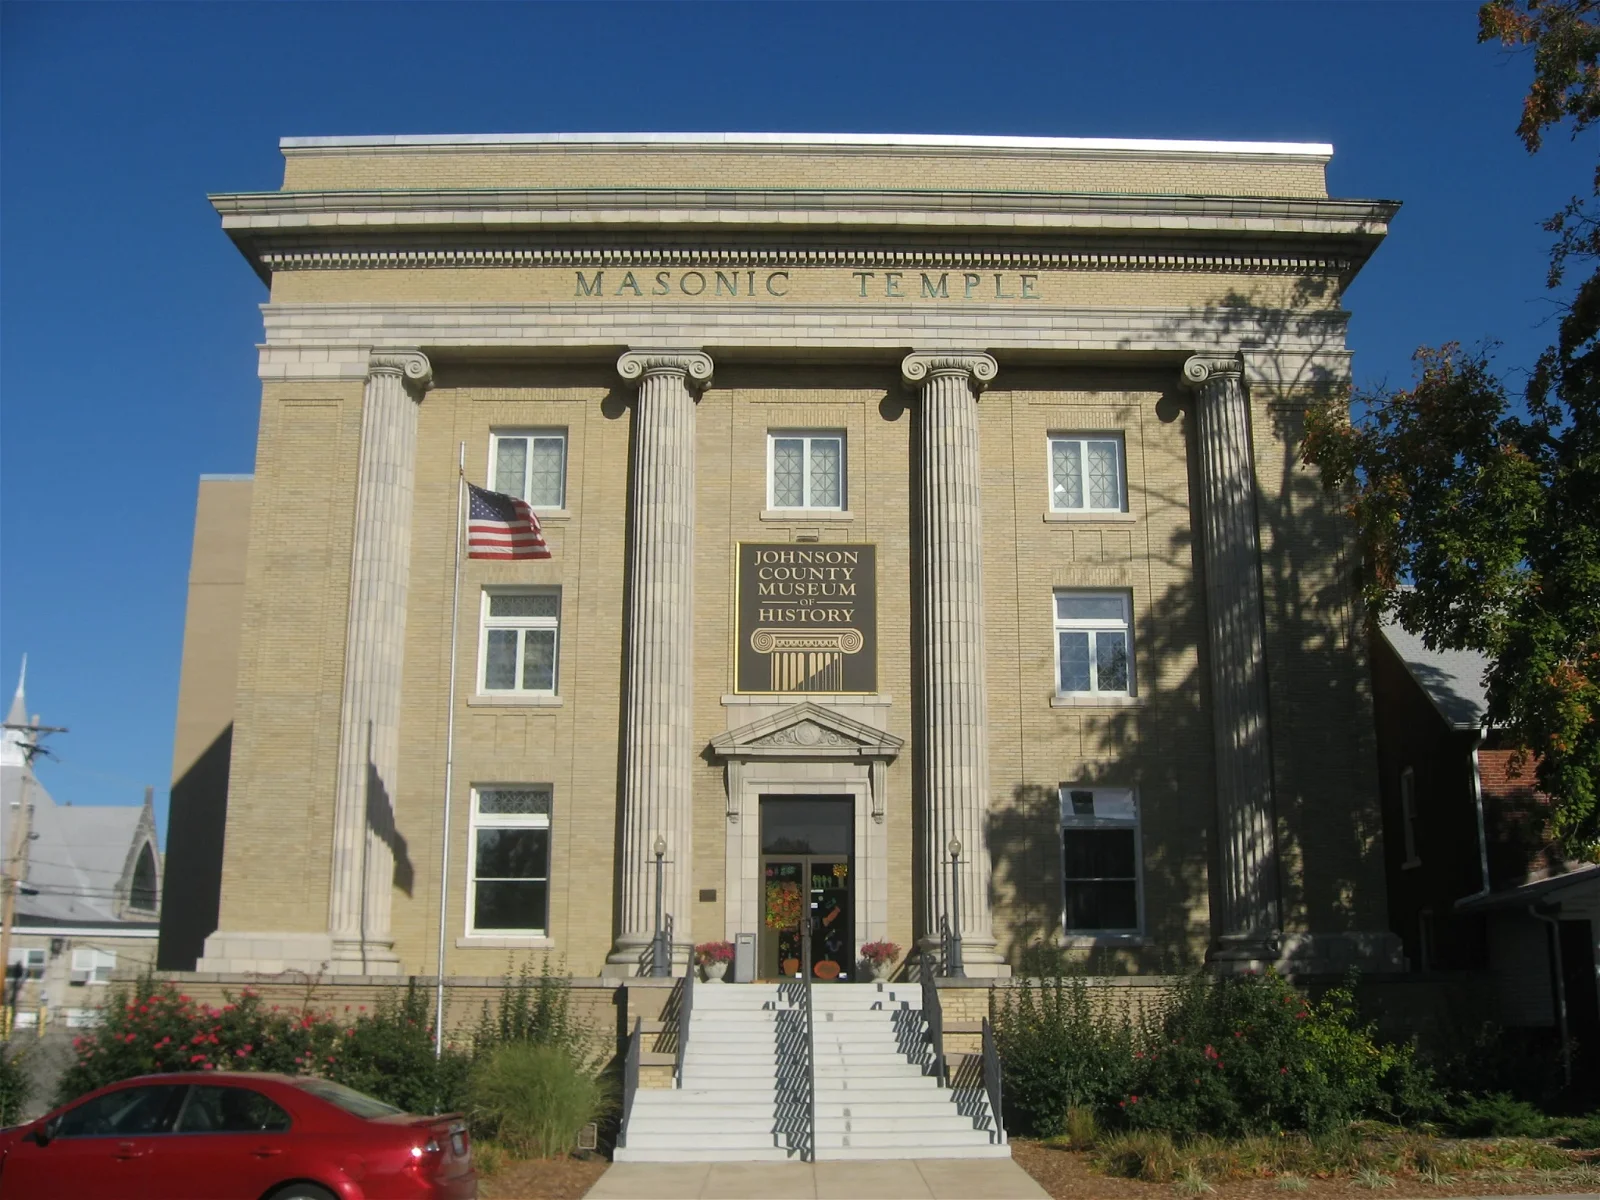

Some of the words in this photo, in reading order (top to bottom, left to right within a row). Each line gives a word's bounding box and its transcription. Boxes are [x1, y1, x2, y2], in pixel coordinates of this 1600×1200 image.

[575, 270, 789, 298] MASONIC
[852, 271, 1040, 300] TEMPLE
[754, 551, 859, 565] JOHNSON
[759, 567, 855, 580] COUNTY
[758, 583, 857, 596] MUSEUM
[758, 609, 855, 622] HISTORY
